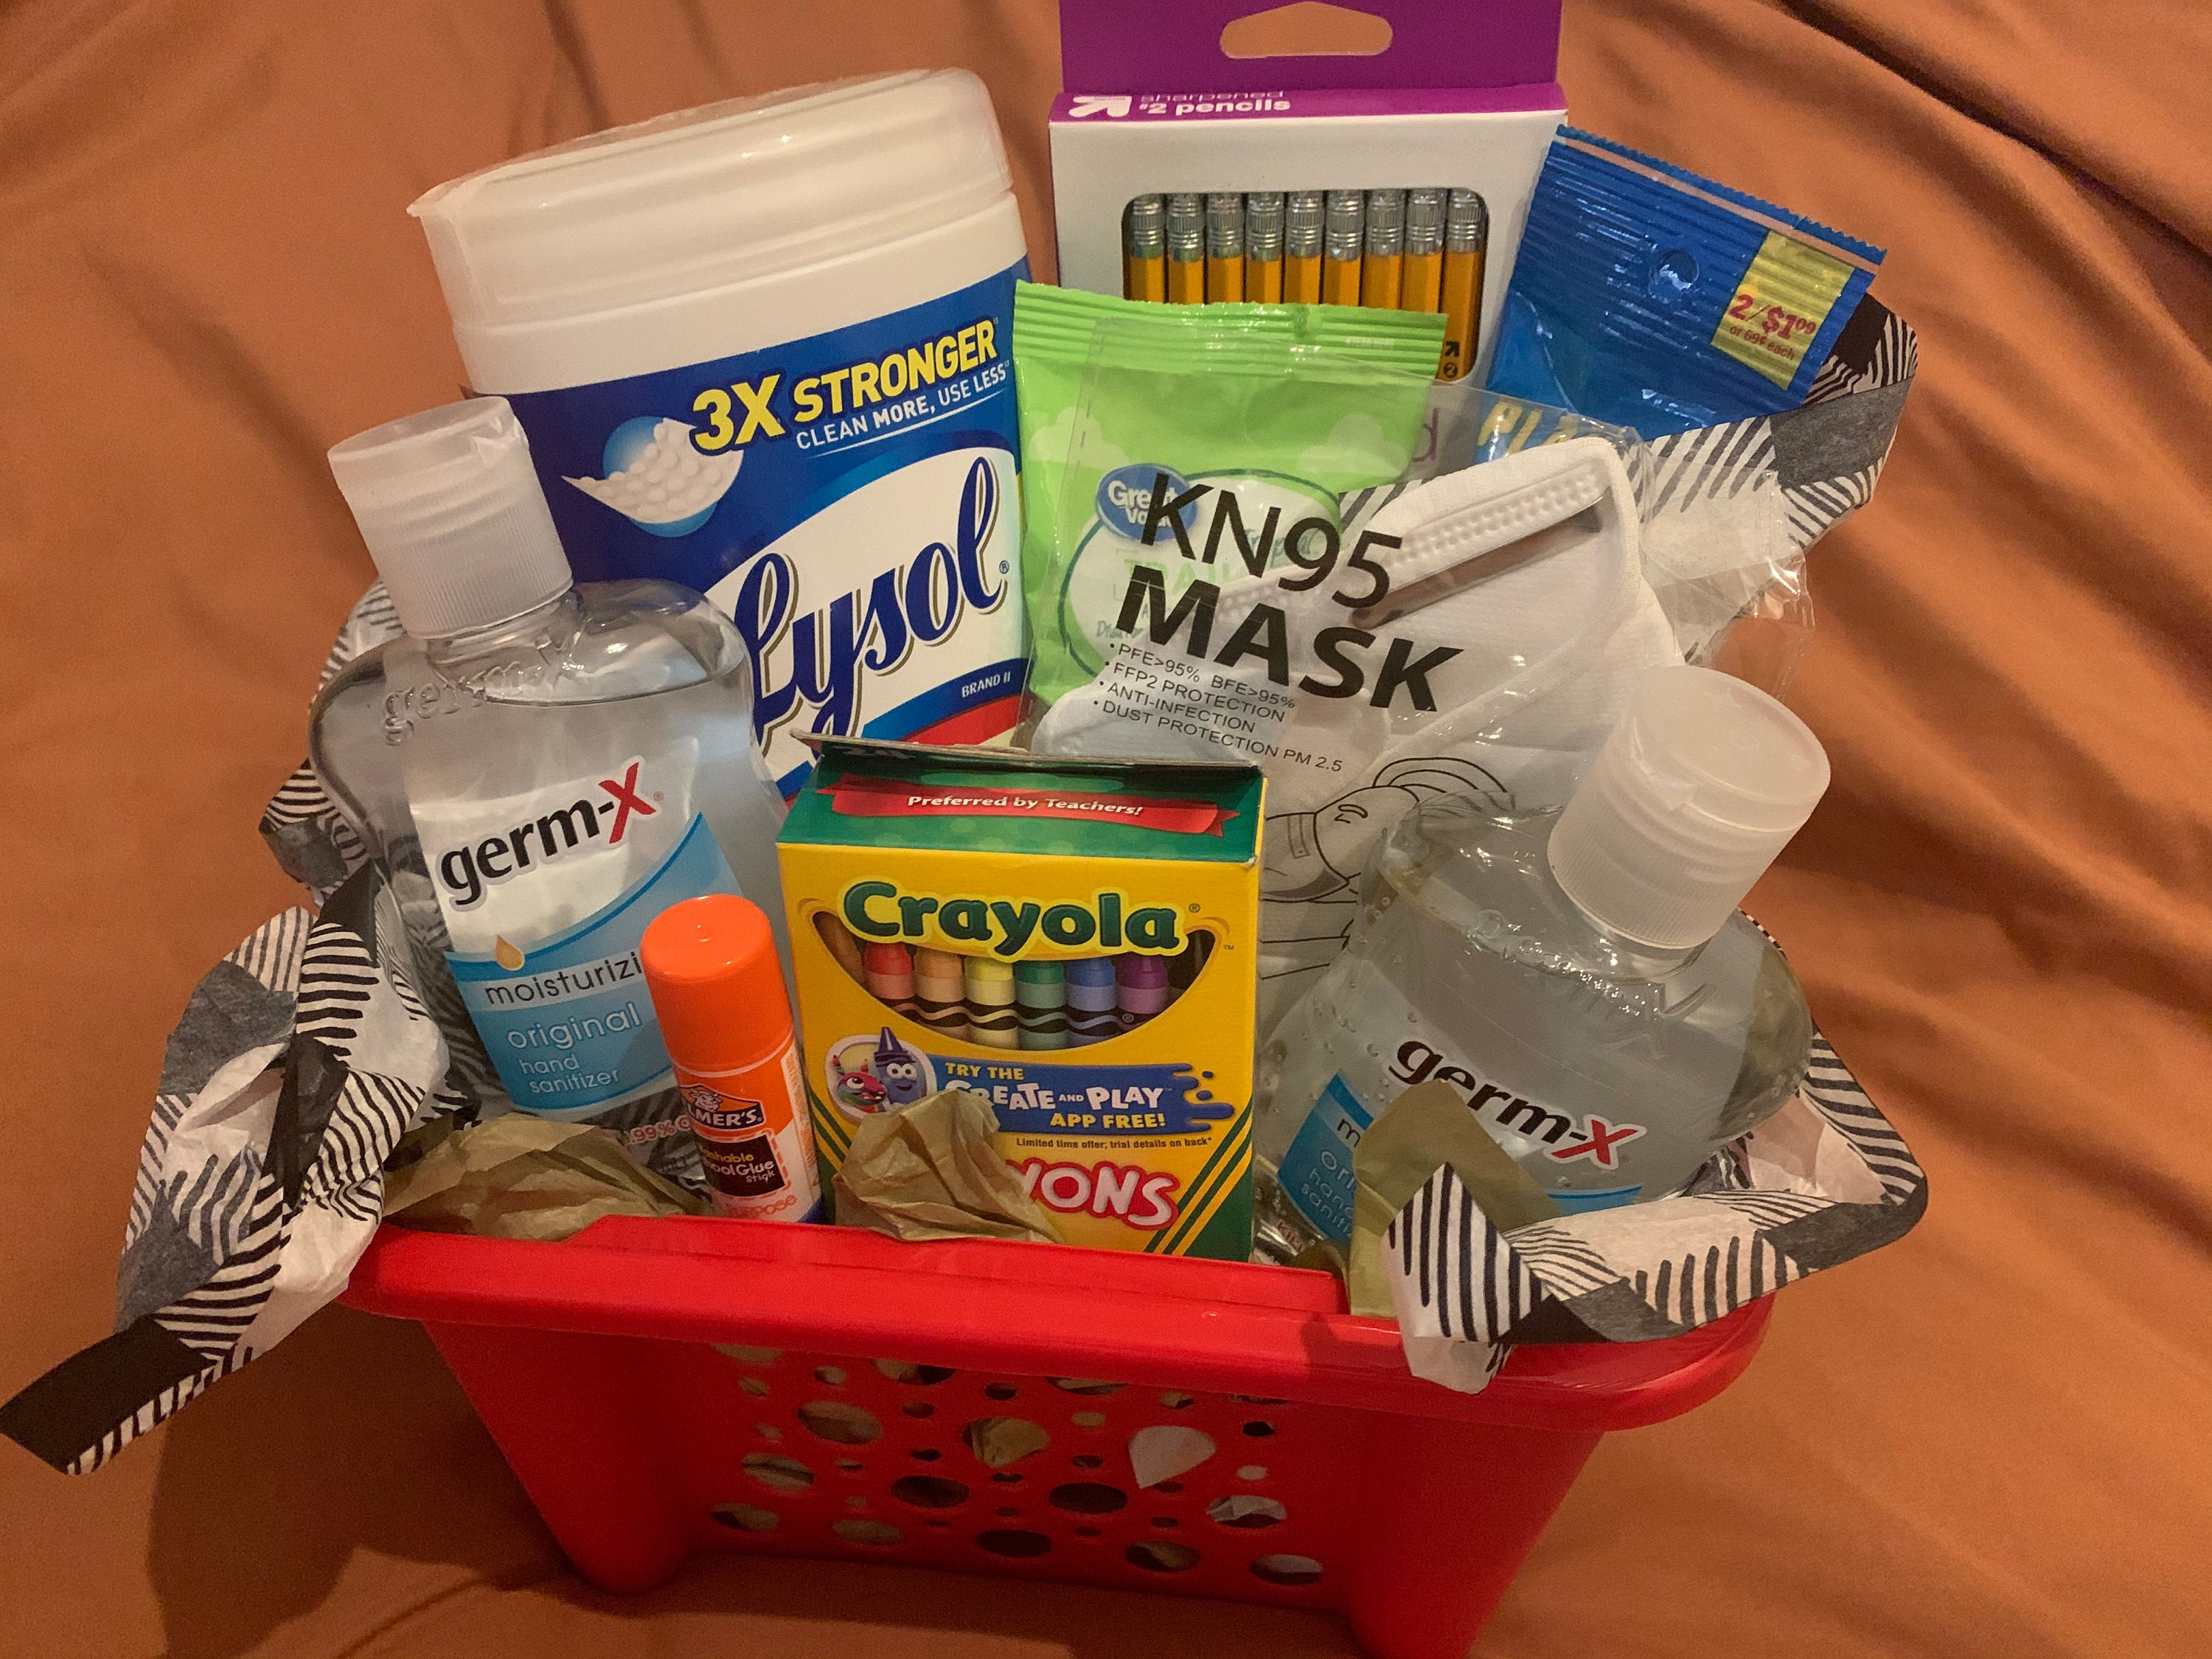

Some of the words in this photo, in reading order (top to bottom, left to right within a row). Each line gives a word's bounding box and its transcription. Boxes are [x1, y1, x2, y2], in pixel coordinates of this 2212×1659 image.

[1175, 99, 1291, 116] pencils
[1730, 326, 1742, 338] or
[1767, 342, 1795, 361] each
[692, 374, 785, 451] 3X
[793, 319, 998, 422] STRONGER
[796, 414, 869, 450] CLEAN
[872, 395, 936, 430] MORE,
[937, 379, 973, 406] USE
[973, 362, 1006, 394] LESS
[1107, 480, 1180, 509] Gret
[1140, 472, 1404, 609] KN95
[734, 455, 1009, 759] Lysol
[1116, 564, 1466, 712] MASK
[961, 674, 1001, 698] BRAND
[1113, 662, 1158, 689] FFP2
[1162, 679, 1286, 723] PROTECTION
[1118, 643, 1200, 683] PFE>95%
[1211, 675, 1296, 709] BFE>95%
[1107, 682, 1256, 734] ANTI-INFECTION
[1102, 700, 1154, 724] DUST
[1158, 716, 1280, 758] PROTECTION
[1283, 749, 1312, 765] PM
[1315, 757, 1343, 773] 2.5
[908, 796, 1008, 807] Preferred
[1013, 796, 1040, 810] by
[1045, 798, 1144, 815] Teachers!
[843, 880, 1181, 956] Crayola
[484, 951, 642, 1006] moisturizi
[507, 1001, 642, 1051] original
[518, 1053, 580, 1074] hand
[529, 1067, 620, 1095] sanitizer
[945, 1062, 982, 1078] TRY
[987, 1066, 1025, 1081] THE
[1058, 1093, 1084, 1103] AND
[1085, 1085, 1165, 1110] PLAY
[687, 1105, 758, 1127] LMER'S
[1050, 1113, 1096, 1129] APP
[1102, 1113, 1166, 1130] FREE!
[698, 1145, 755, 1163] shable
[1016, 1137, 1054, 1147] Limited
[1057, 1138, 1079, 1148] time
[1110, 1139, 1131, 1149] trial
[1133, 1138, 1166, 1149] details
[736, 1160, 775, 1176] Glue
[1013, 1161, 1178, 1229] YONS
